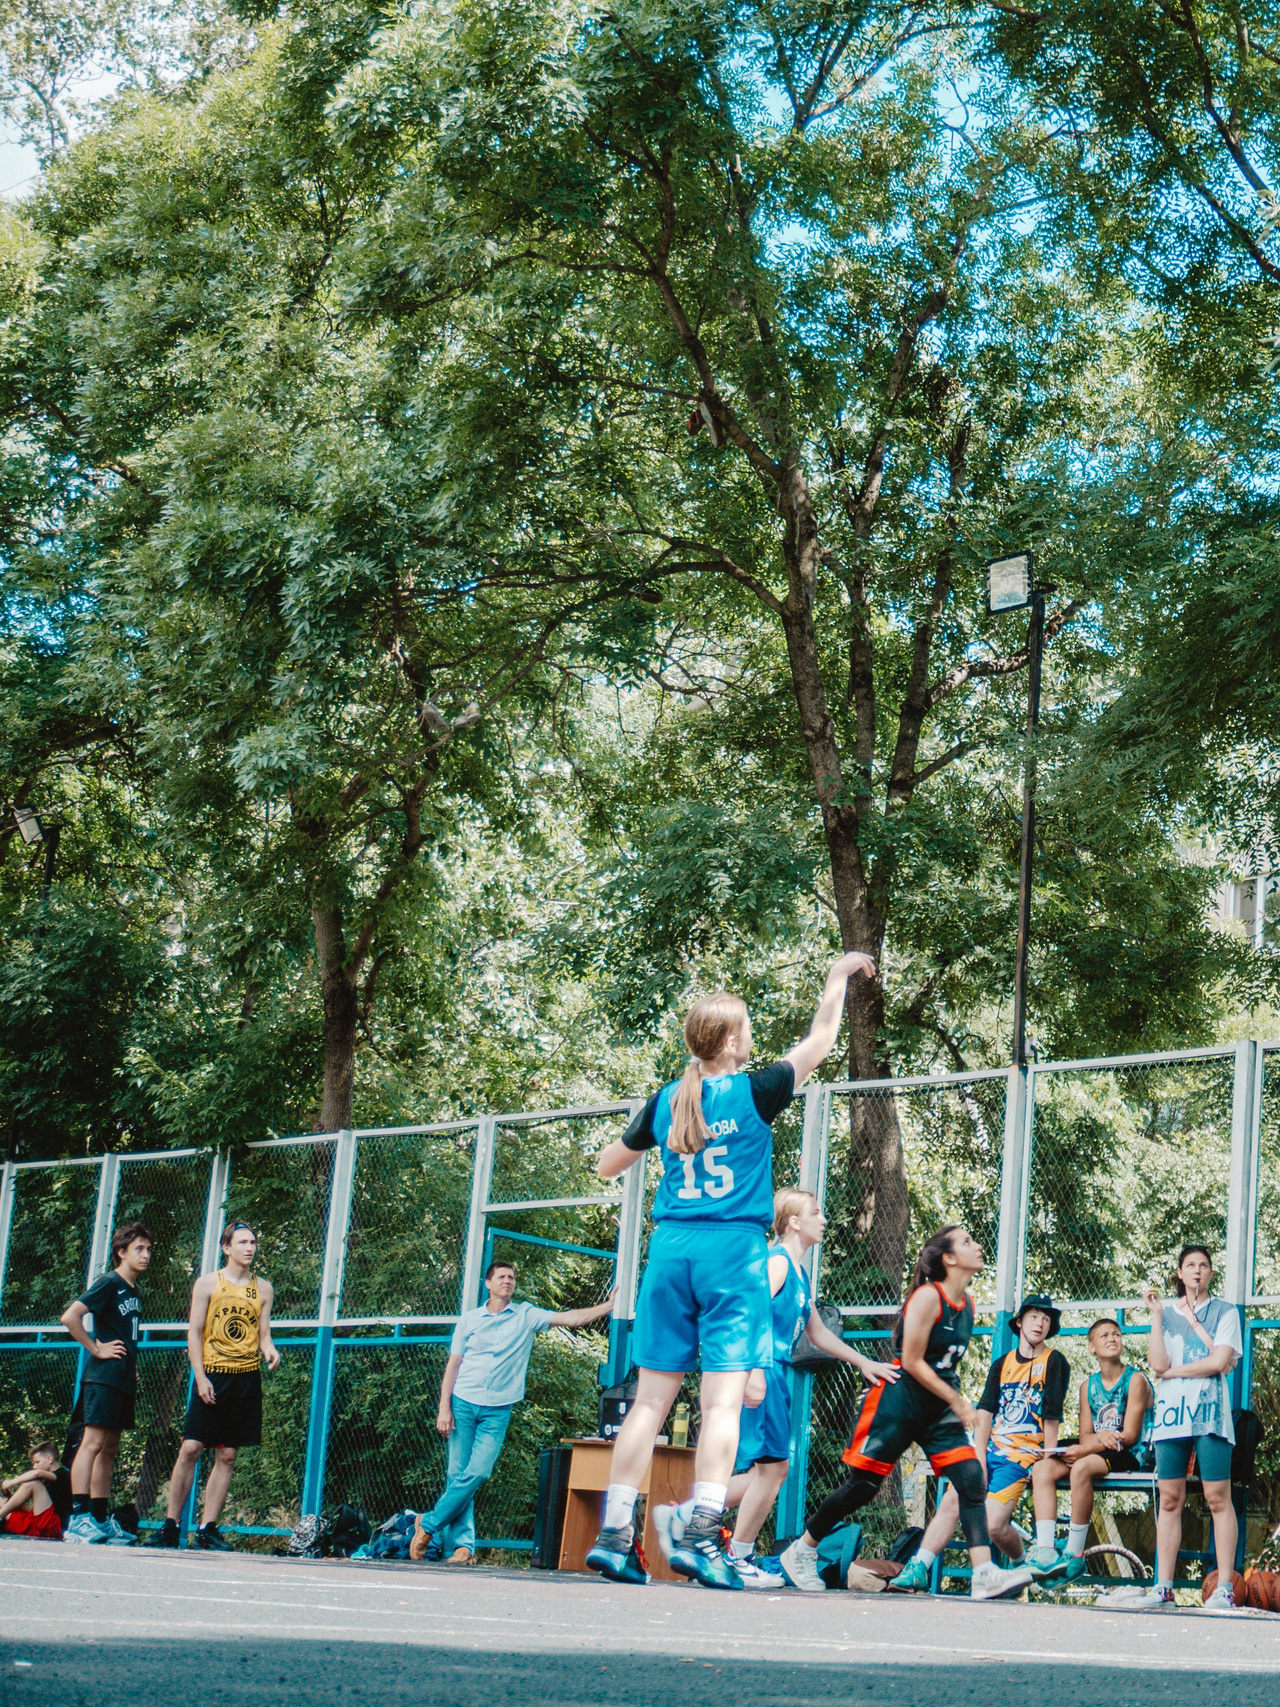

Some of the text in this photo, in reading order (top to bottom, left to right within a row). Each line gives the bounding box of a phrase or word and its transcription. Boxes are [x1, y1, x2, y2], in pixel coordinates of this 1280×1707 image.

[678, 1145, 735, 1199] 15
[245, 1287, 257, 1299] 58
[214, 1305, 257, 1325] УРАГАН
[1153, 1395, 1220, 1429] Calvin
